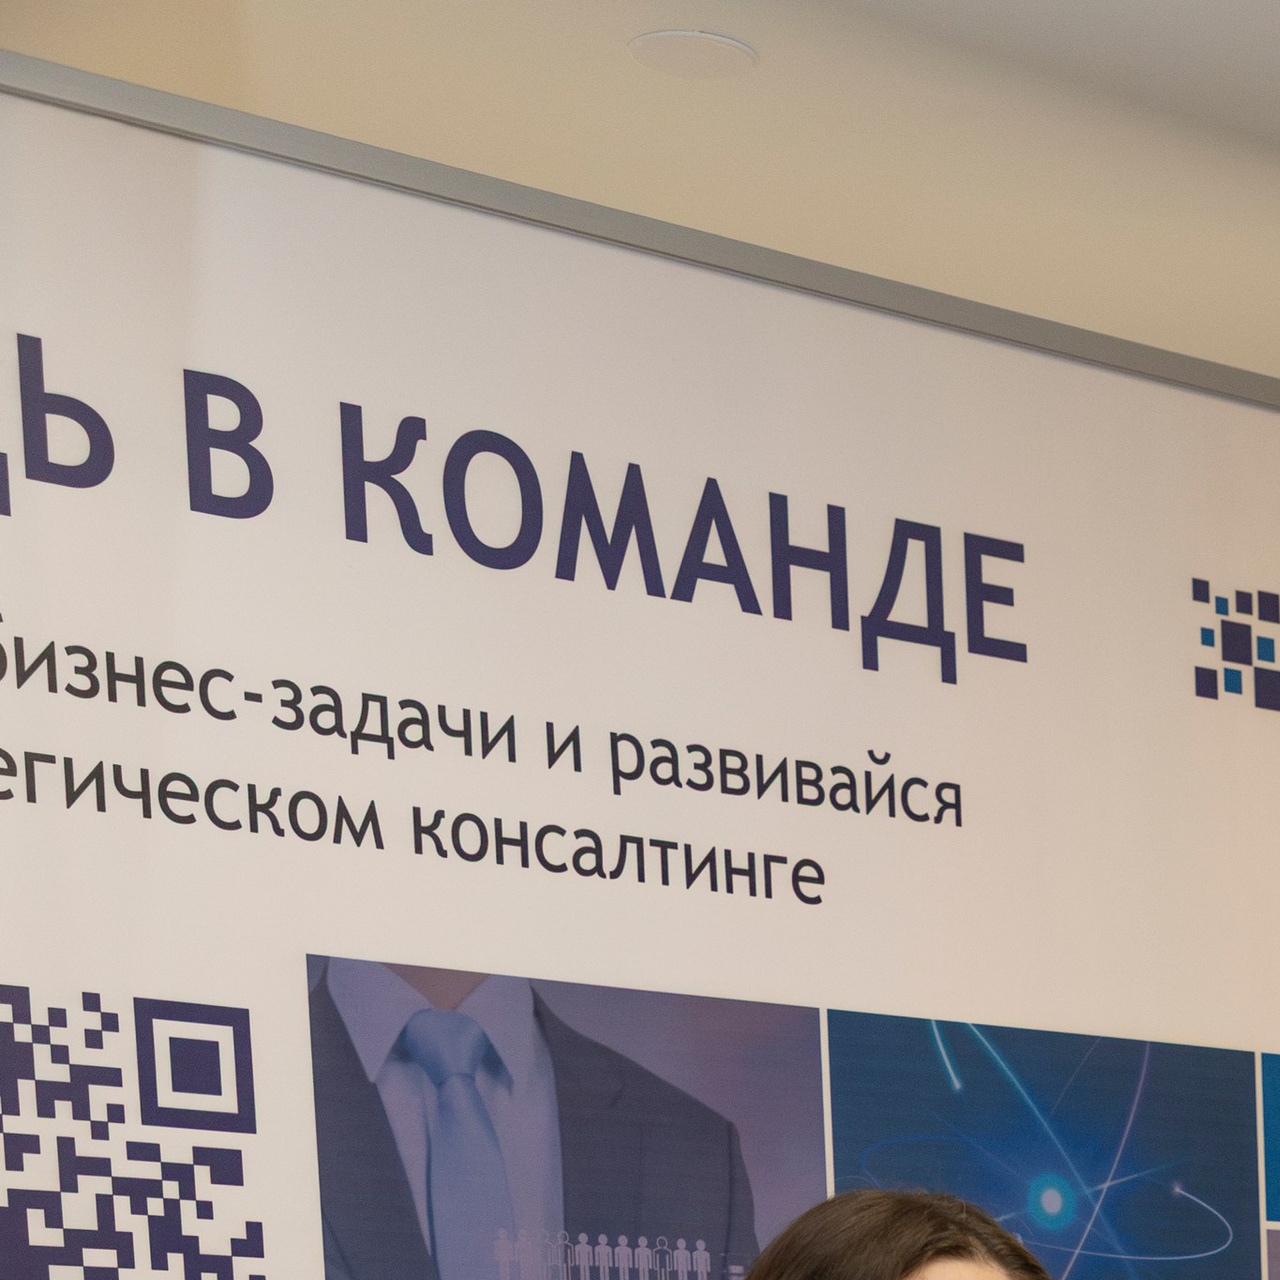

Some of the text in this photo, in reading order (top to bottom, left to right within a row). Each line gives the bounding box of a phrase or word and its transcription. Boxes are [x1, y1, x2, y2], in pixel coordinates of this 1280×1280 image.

[0, 332, 1029, 686] Ь В КОМАНДЕ
[0, 612, 963, 827] изнес-задачи и развивайся
[411, 805, 826, 906] консалтинге
